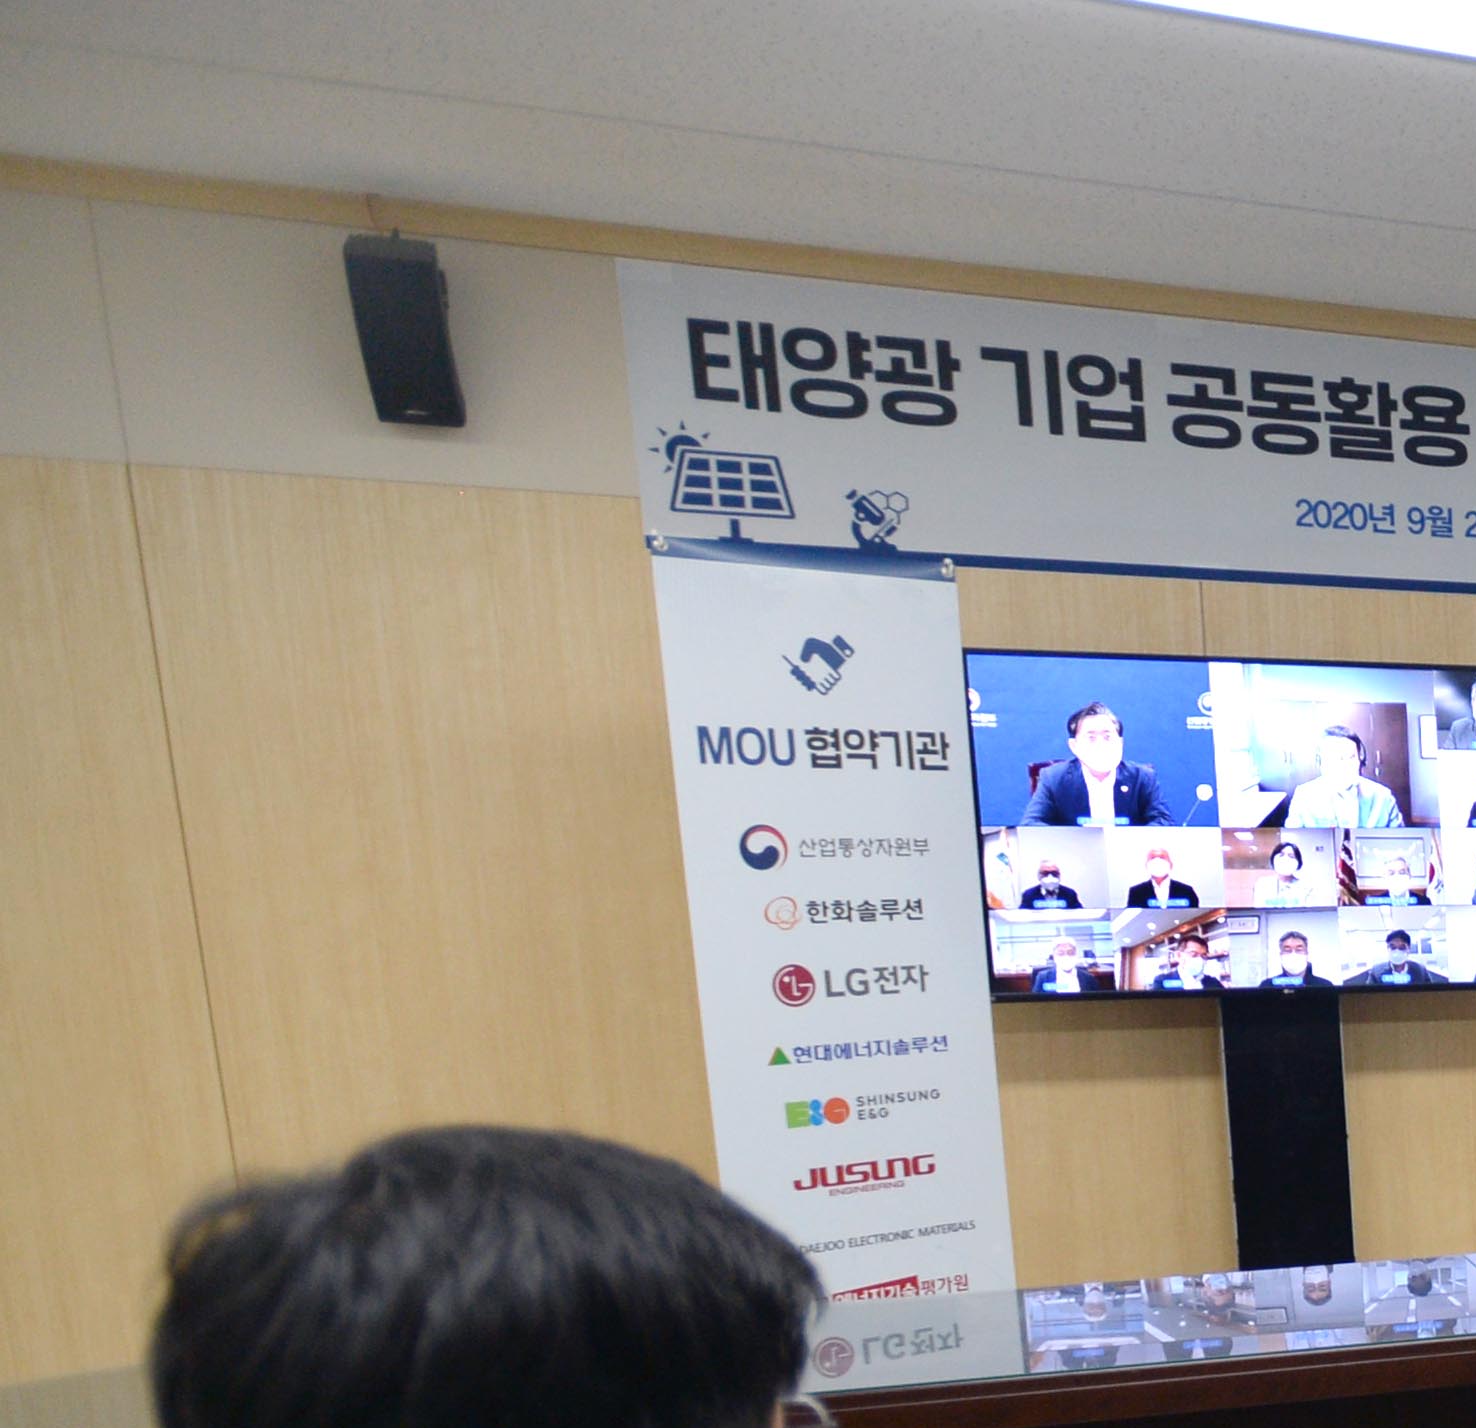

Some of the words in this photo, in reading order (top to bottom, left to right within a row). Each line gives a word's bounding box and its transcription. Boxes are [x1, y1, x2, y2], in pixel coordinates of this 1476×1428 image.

[686, 317, 960, 427] 태양광
[980, 346, 1146, 443] 기업
[1166, 362, 1470, 466] 공동활용
[1295, 498, 1397, 536] 2020년
[1406, 504, 1455, 539] 9월
[697, 725, 796, 766] MOU
[804, 726, 951, 771] 협약기관
[799, 837, 930, 859] 산업통상자원부
[806, 898, 925, 924] 한화솔루션
[824, 964, 929, 998] LG전자
[793, 1035, 949, 1064] 현대에너지솔루션
[856, 1088, 941, 1107] SHINSUNG
[858, 1107, 890, 1121] E&G
[793, 1153, 936, 1191] JUSUNG
[829, 1180, 905, 1197] ENGINEERING
[848, 1229, 915, 1249] ELECTRONIC
[918, 1220, 976, 1237] MATERIALS
